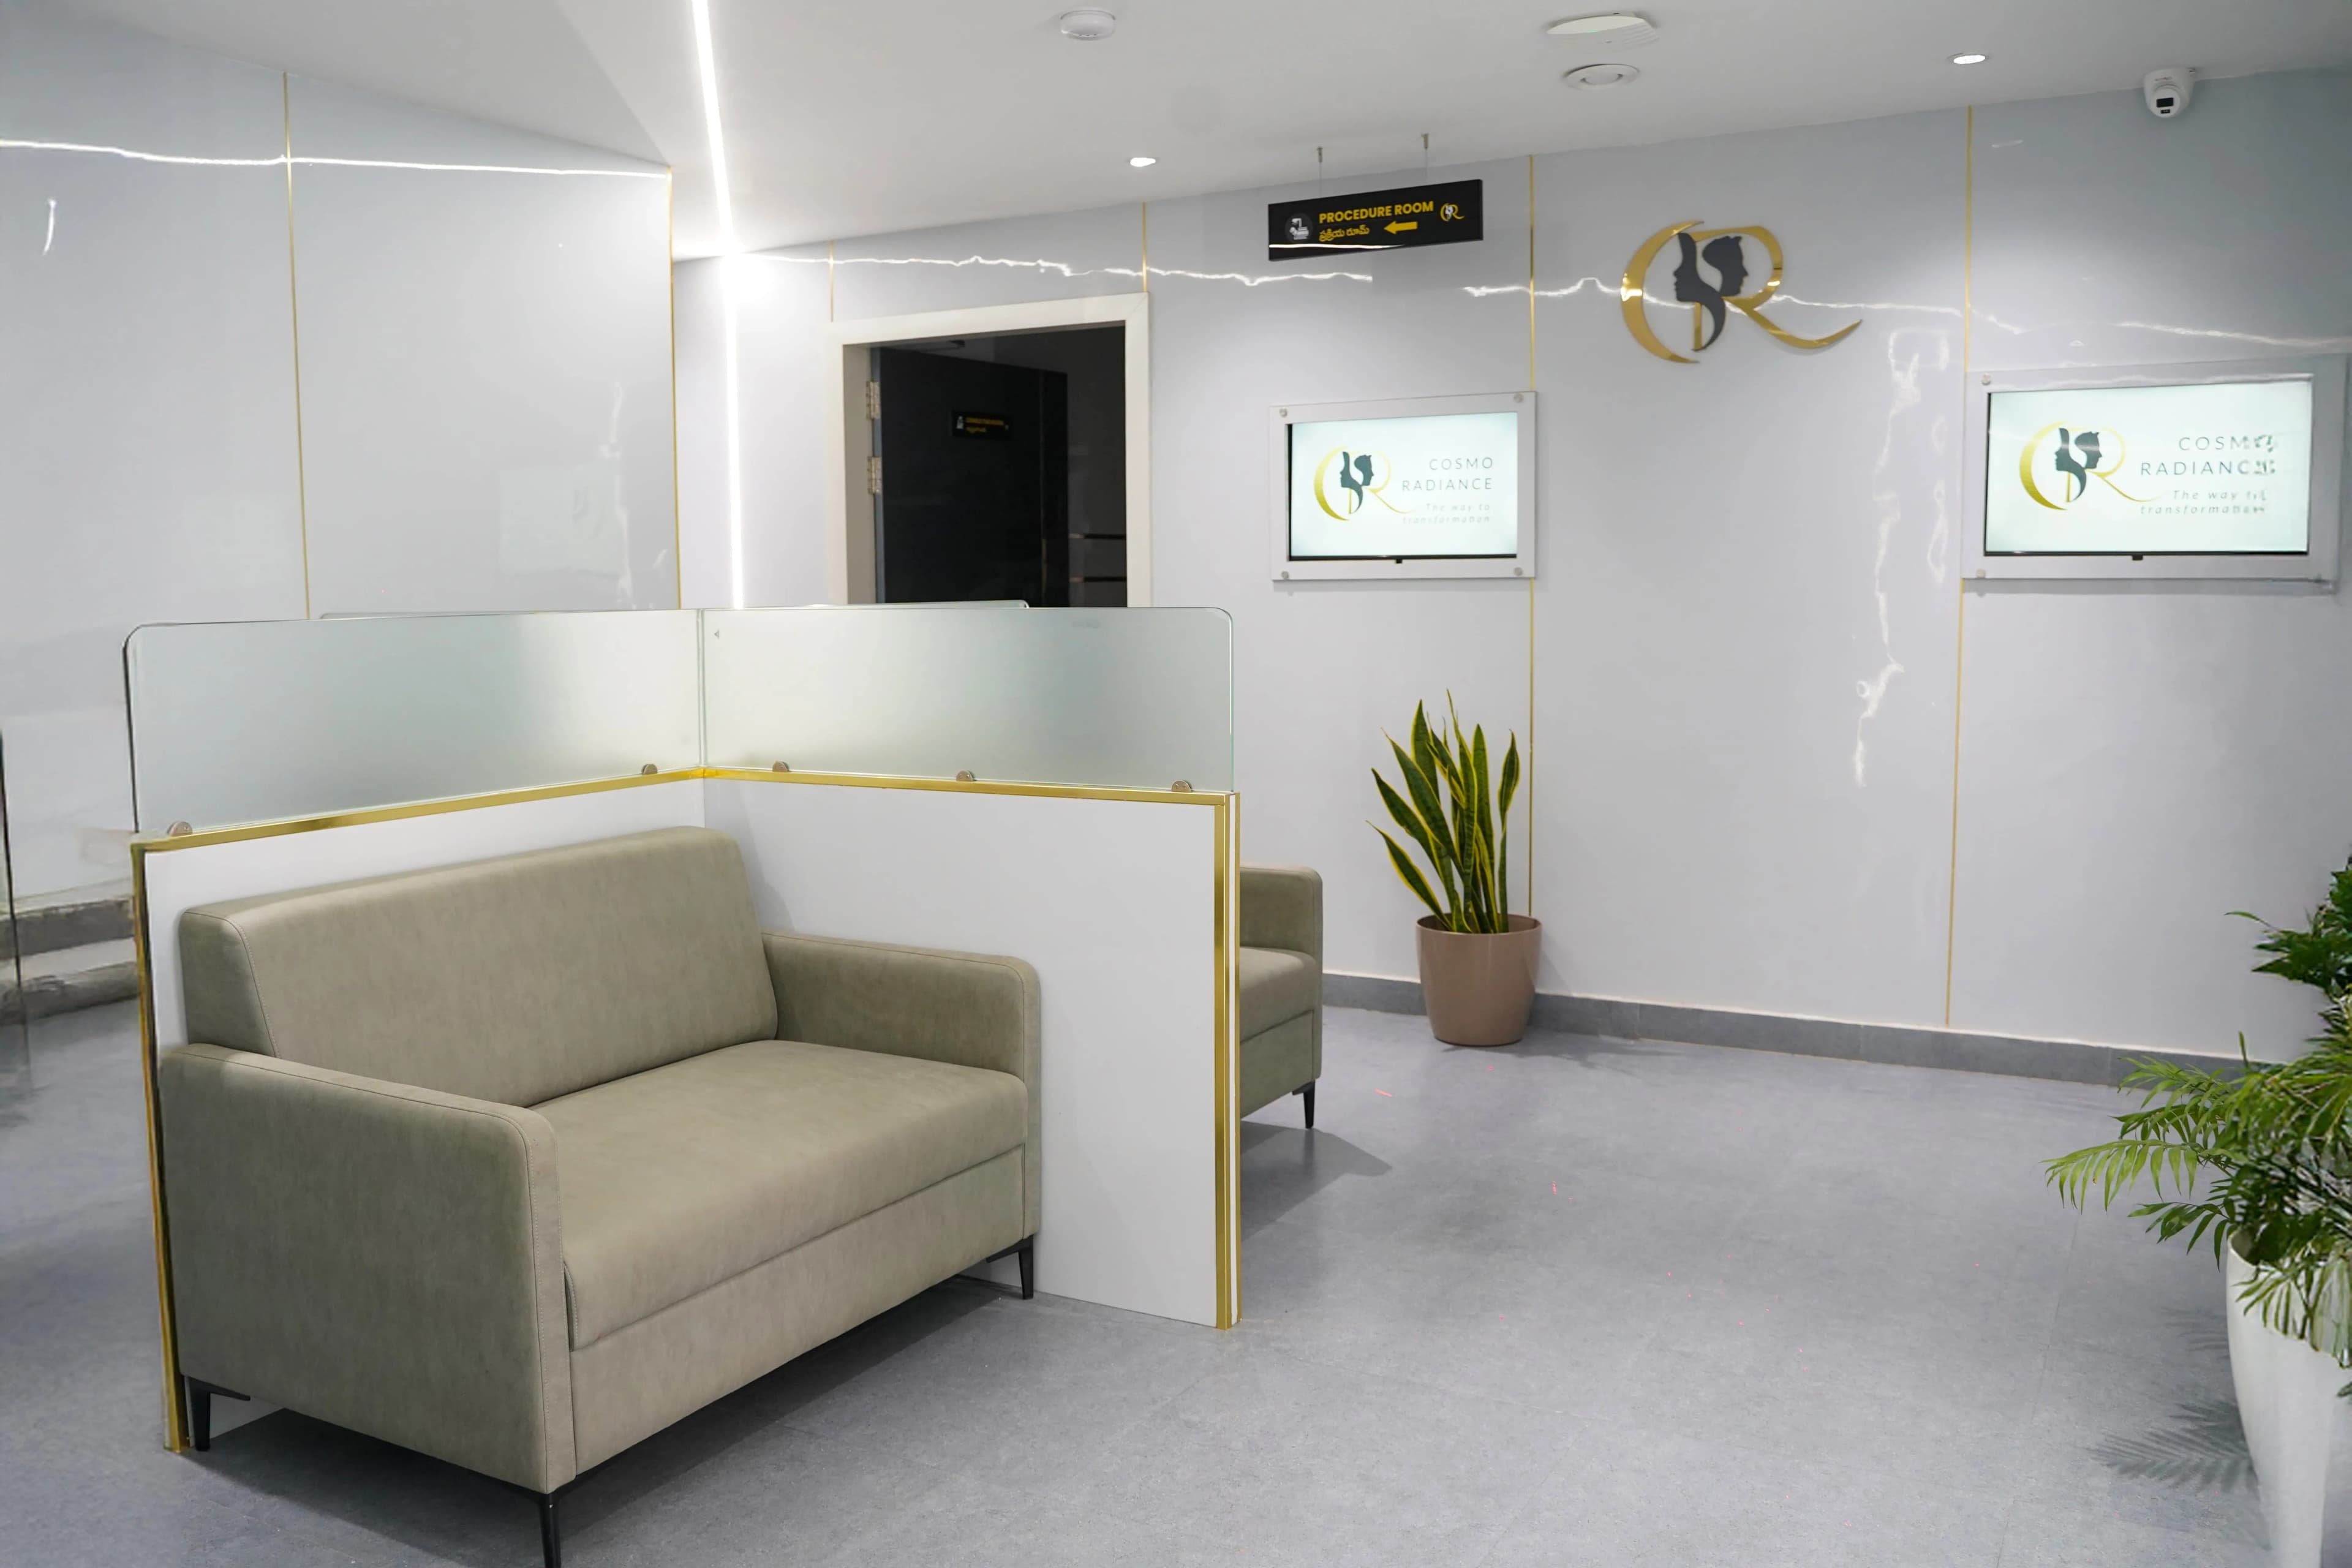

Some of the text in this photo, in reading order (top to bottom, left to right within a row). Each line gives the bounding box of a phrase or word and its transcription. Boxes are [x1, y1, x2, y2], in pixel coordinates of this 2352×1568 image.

[1319, 200, 1434, 224] PROCEDURE ROOM
[1429, 457, 1493, 470] COSMO
[1401, 478, 1492, 491] RADIANCE
[2173, 490, 2199, 500] The
[2207, 491, 2239, 501] way
